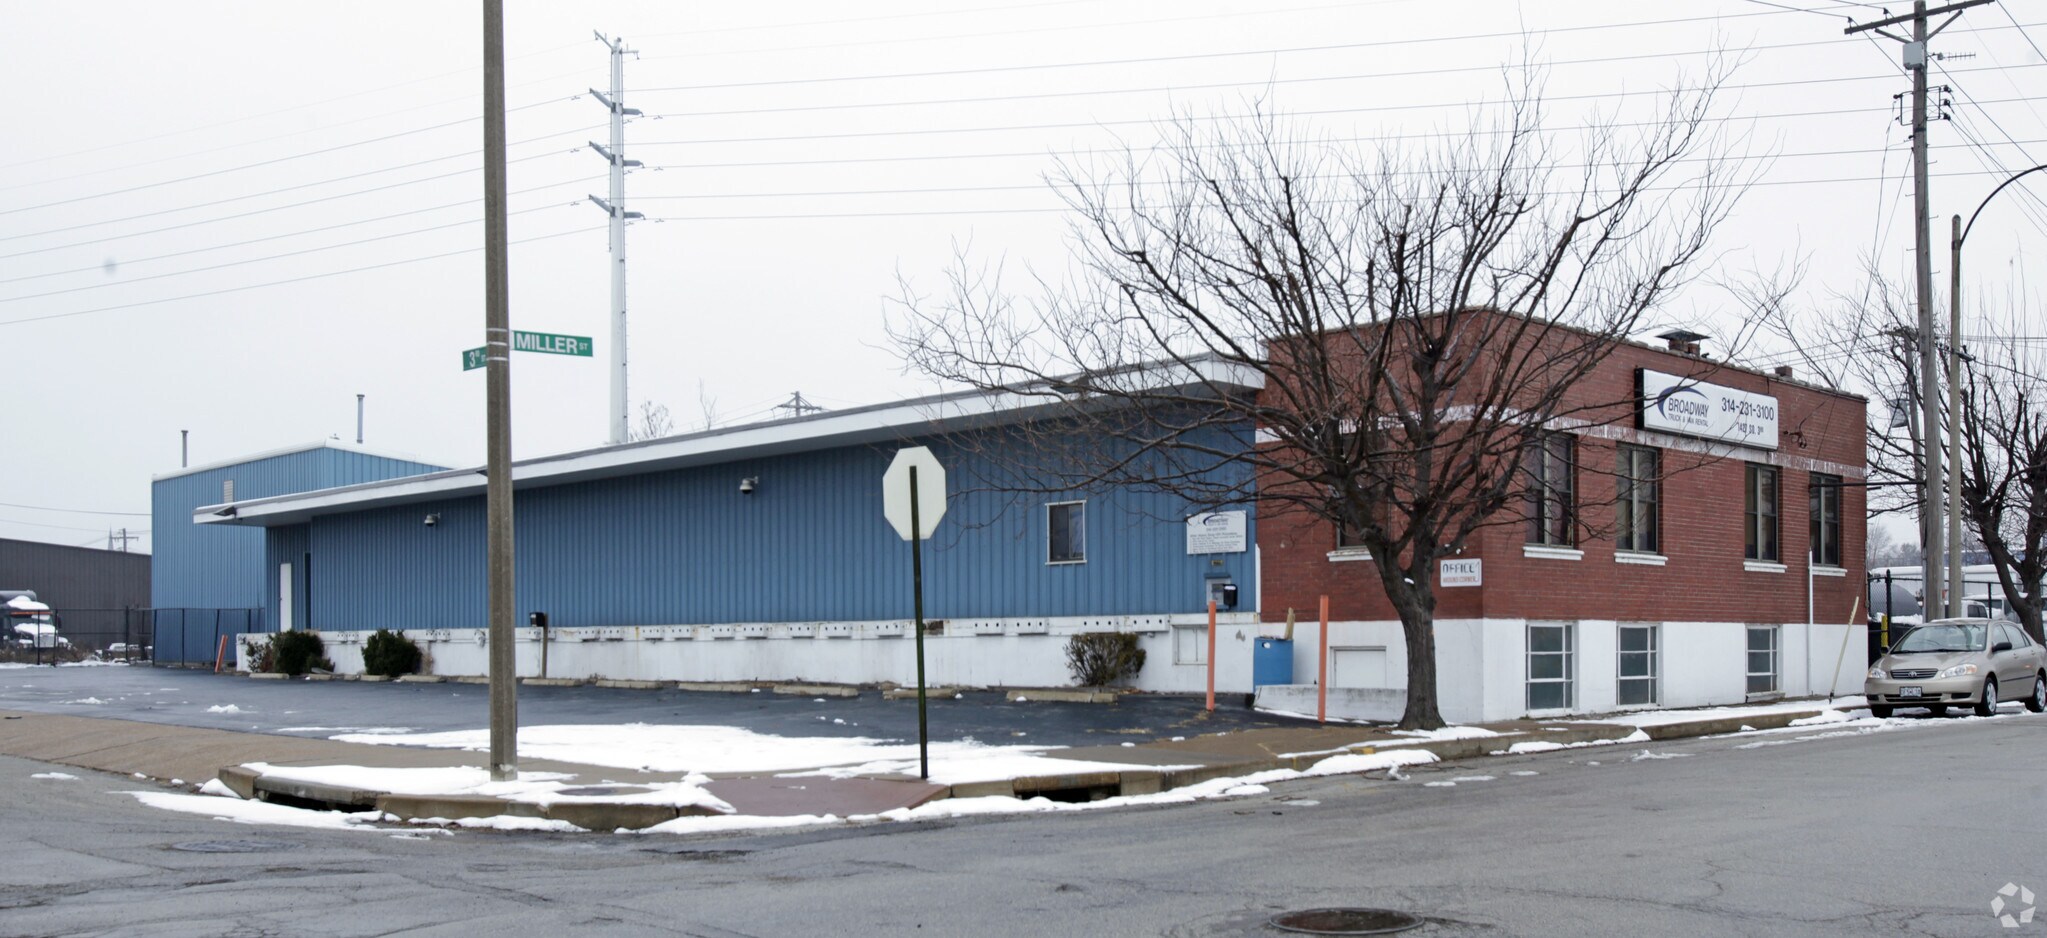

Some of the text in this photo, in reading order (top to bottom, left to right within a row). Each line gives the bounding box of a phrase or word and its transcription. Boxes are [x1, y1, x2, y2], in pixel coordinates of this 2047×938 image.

[516, 332, 578, 354] MILLER
[1668, 398, 1709, 418] BROADWAY
[1721, 397, 1774, 421] 314-231-3100
[1668, 413, 1681, 422] TRUCK
[1695, 418, 1709, 427] RENTAL
[1442, 563, 1475, 574] OFFICE
